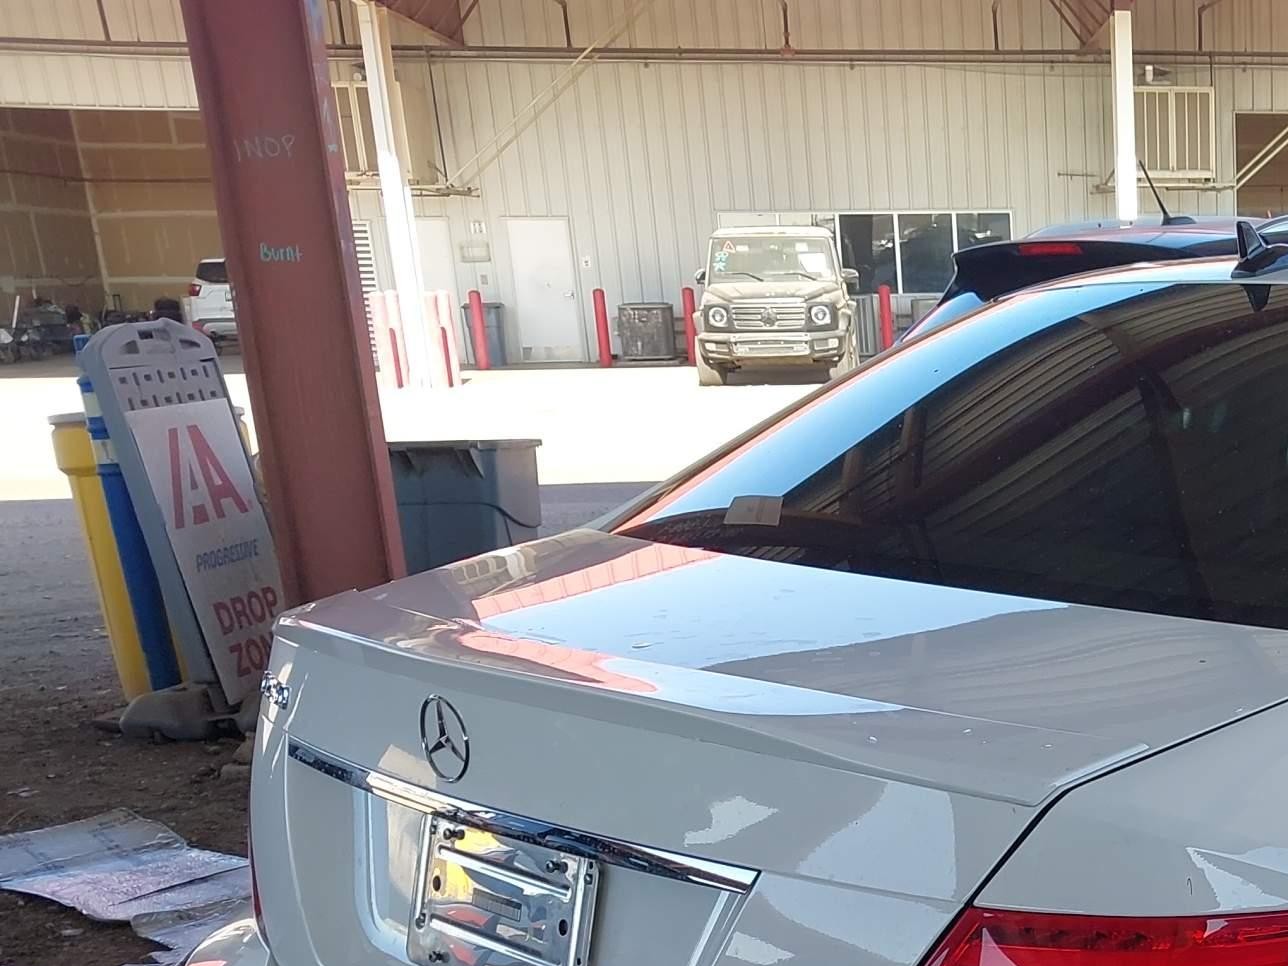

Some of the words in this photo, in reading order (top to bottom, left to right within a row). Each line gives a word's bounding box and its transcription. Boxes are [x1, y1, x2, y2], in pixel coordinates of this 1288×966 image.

[259, 242, 305, 263] Burnt
[168, 424, 250, 530] IAA
[195, 538, 260, 573] PROGRESSIVE
[213, 586, 278, 636] DROP
[228, 631, 274, 678] ZON
